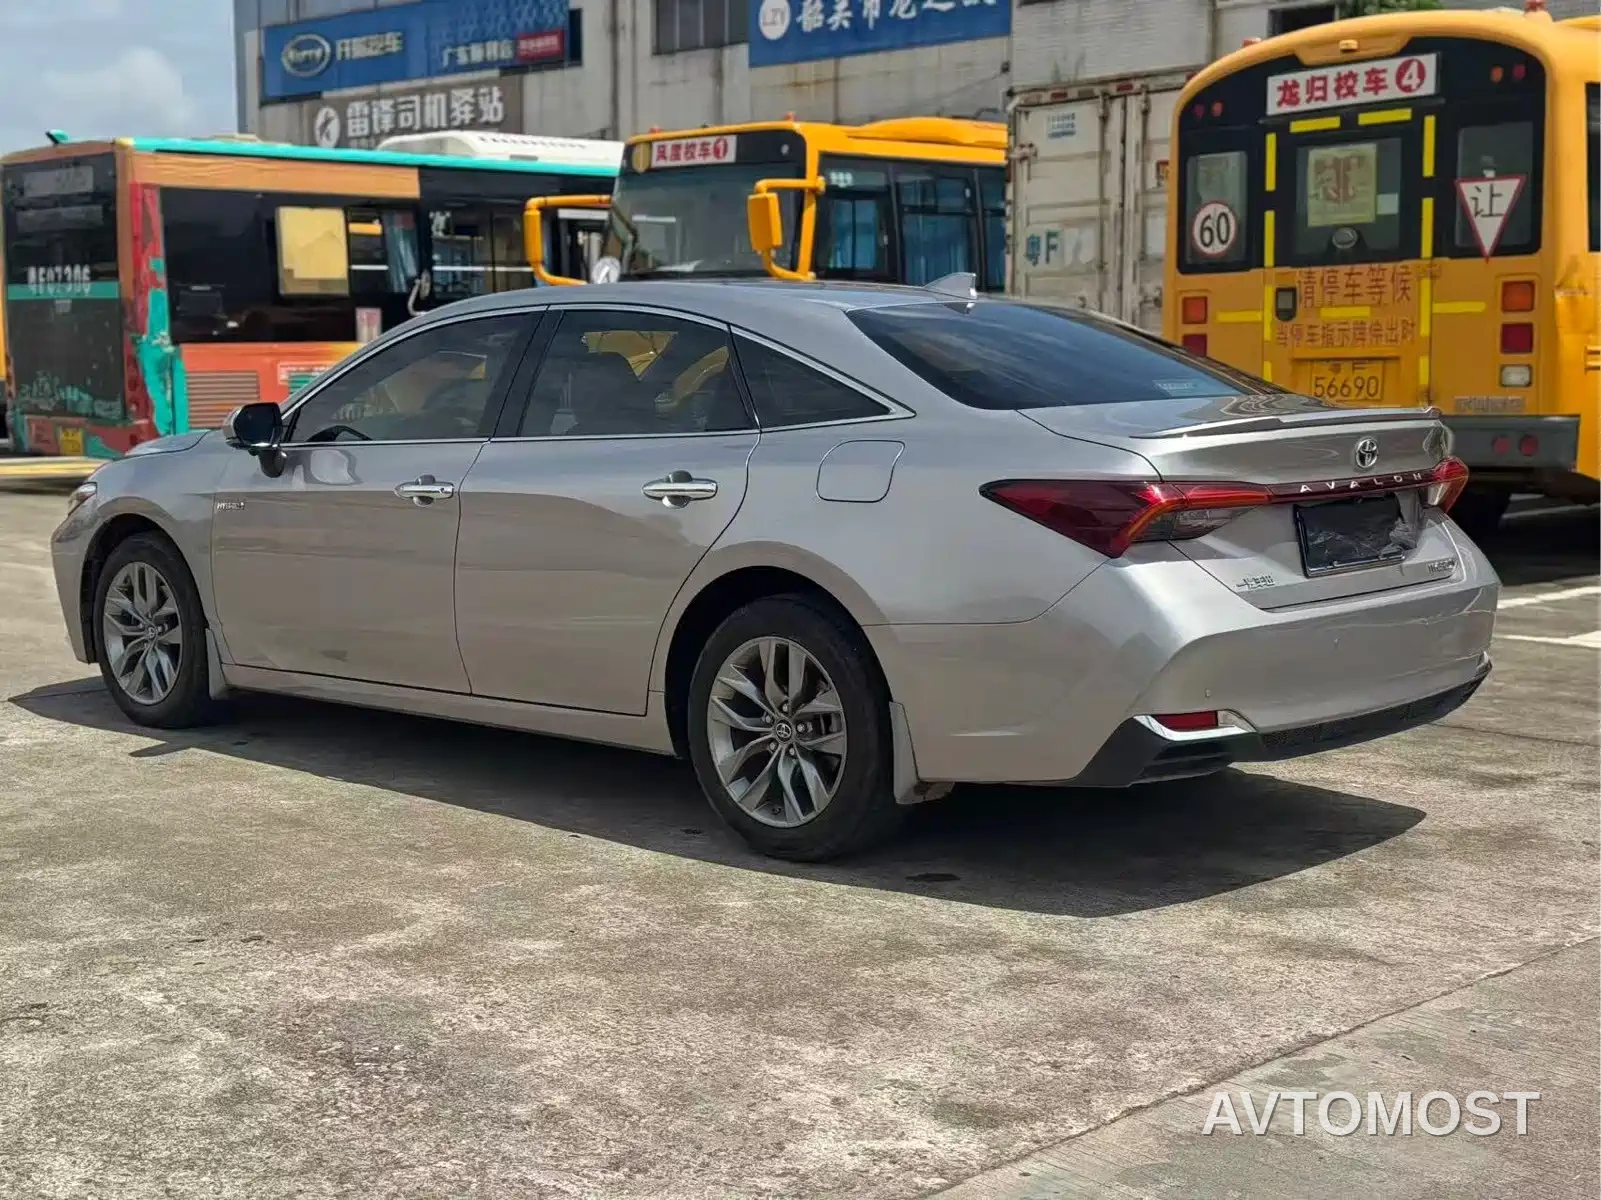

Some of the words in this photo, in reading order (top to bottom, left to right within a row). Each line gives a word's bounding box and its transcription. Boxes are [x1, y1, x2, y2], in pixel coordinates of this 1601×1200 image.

[347, 86, 505, 138] 雷锋司机驿站
[1470, 183, 1504, 218] 让
[1200, 212, 1230, 248] 60
[1314, 376, 1379, 398] 56690
[1300, 472, 1423, 493] AVALON
